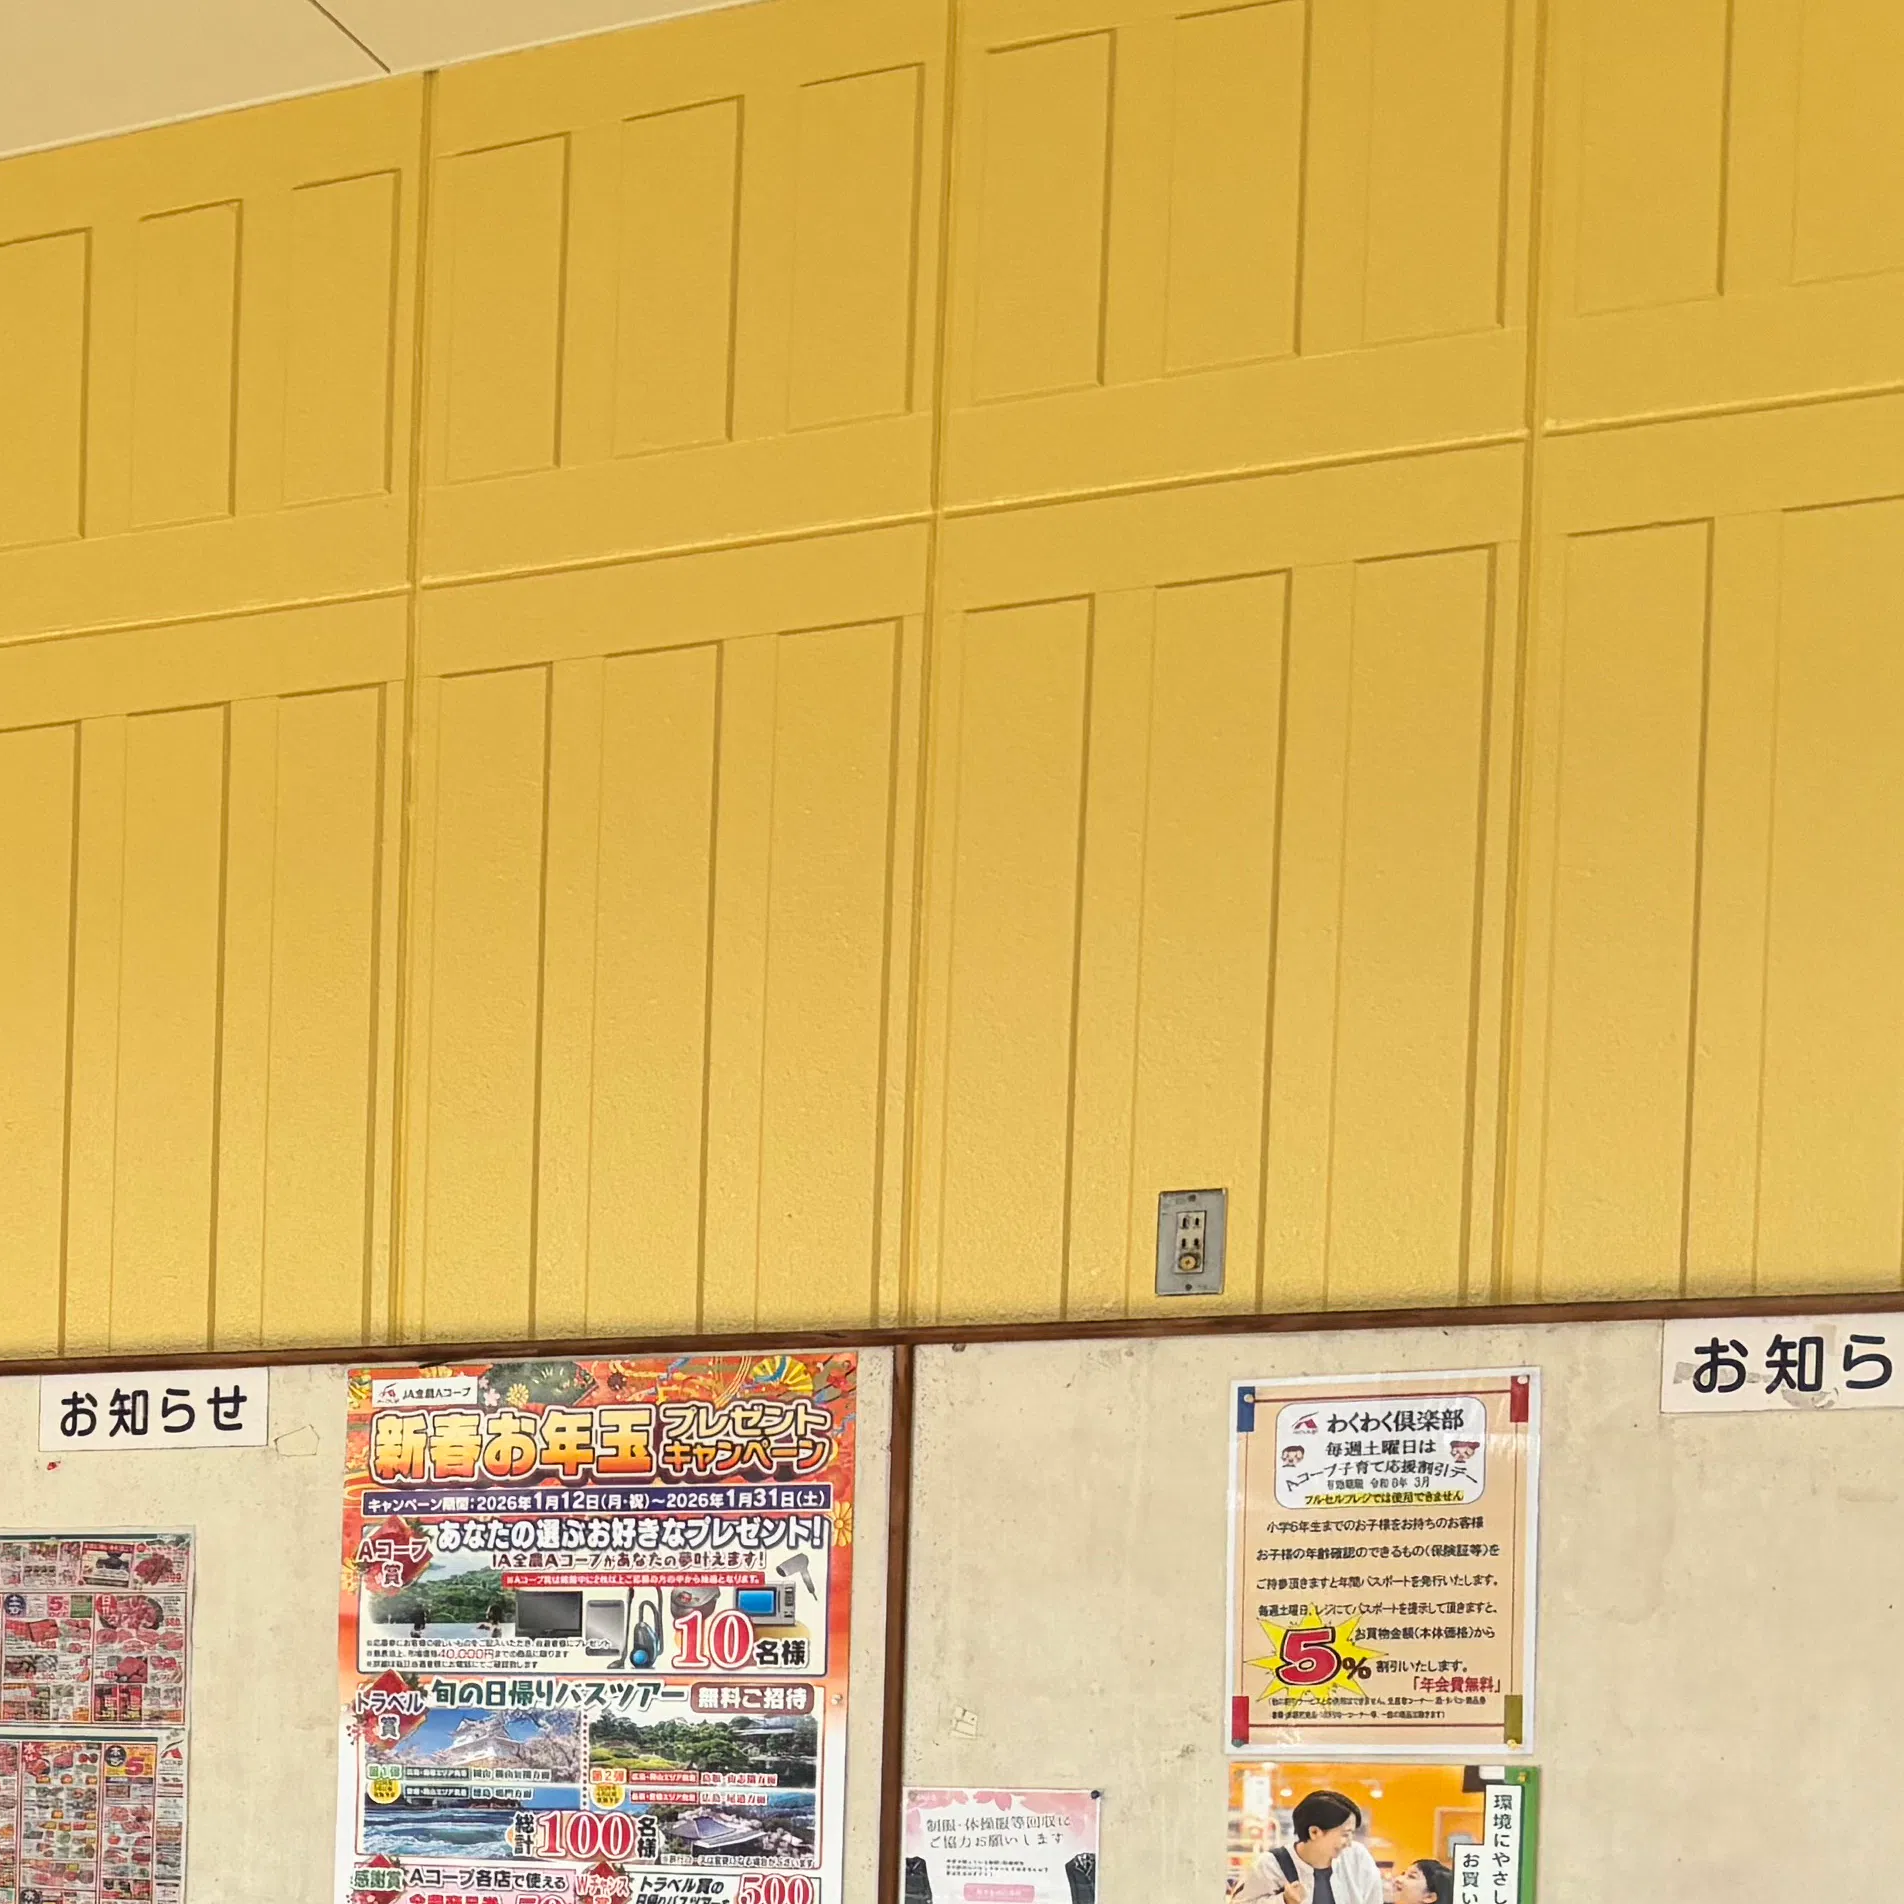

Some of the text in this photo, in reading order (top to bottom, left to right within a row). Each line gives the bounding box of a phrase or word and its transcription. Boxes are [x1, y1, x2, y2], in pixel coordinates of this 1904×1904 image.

[60, 1384, 247, 1437] お知らせ
[1326, 1409, 1464, 1433] わくわく倶楽部
[372, 1402, 828, 1480] 新春お年玉 プレゼント
[1326, 1439, 1436, 1457] 毎週土曜日は
[663, 1438, 825, 1473] キャンペーン
[1414, 1476, 1430, 1488] 3月
[437, 1515, 824, 1551] あなたの選ぶお好きなプレゼント!
[357, 1539, 430, 1562] Aコープ
[672, 1609, 809, 1670] 10 名様
[1275, 1626, 1468, 1686] 5% 割引いたします。
[432, 1679, 808, 1710] 旬の日帰りバスツアー 無料ご招待
[1414, 1676, 1501, 1693] 「年会費無料」
[356, 1691, 425, 1714] トラベル
[538, 1811, 634, 1860] 100
[637, 1816, 658, 1859] 名様
[930, 1833, 1063, 1849] ご協力お願いします
[354, 1869, 403, 1890] 感謝賞
[409, 1869, 567, 1890] Aコープ各店で使える
[576, 1873, 631, 1898] Wチャンス
[640, 1877, 724, 1895] トラベル賞の
